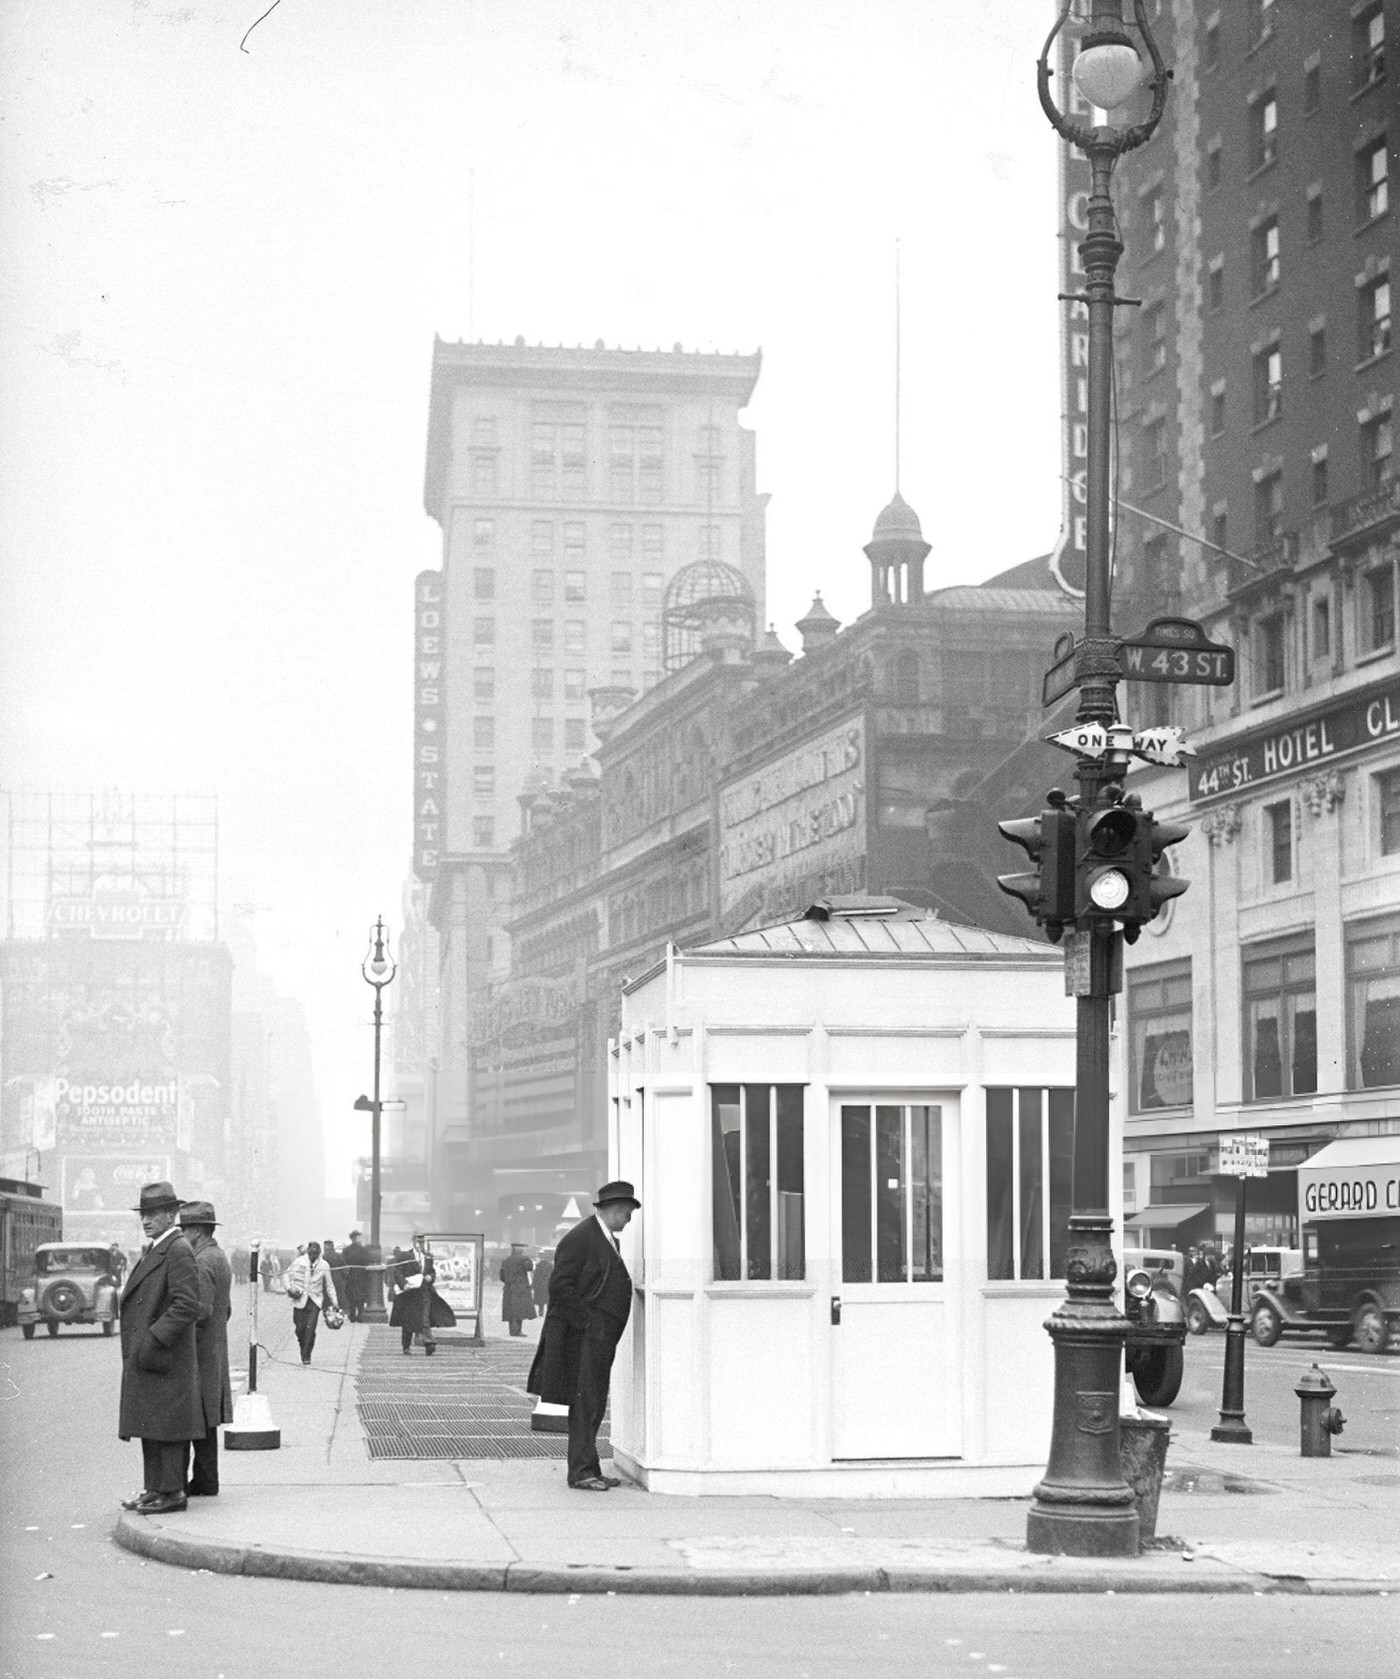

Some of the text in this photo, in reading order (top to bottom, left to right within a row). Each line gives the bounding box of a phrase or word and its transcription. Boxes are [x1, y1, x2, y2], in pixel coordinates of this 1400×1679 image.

[1125, 651, 1227, 678] W. 43 ST.
[1077, 734, 1168, 751] ONE WAY
[1198, 763, 1230, 795] 44TH
[1233, 756, 1252, 788] ST.
[1264, 721, 1335, 773] HOTEL
[420, 746, 440, 867] STATE
[54, 904, 180, 923] CHEVROLET
[55, 1078, 177, 1108] Pepsodent
[76, 1106, 158, 1116] TOOTH PASTE
[80, 1116, 150, 1126] ANTISEPTIC
[1305, 1179, 1400, 1212] GERARD C
